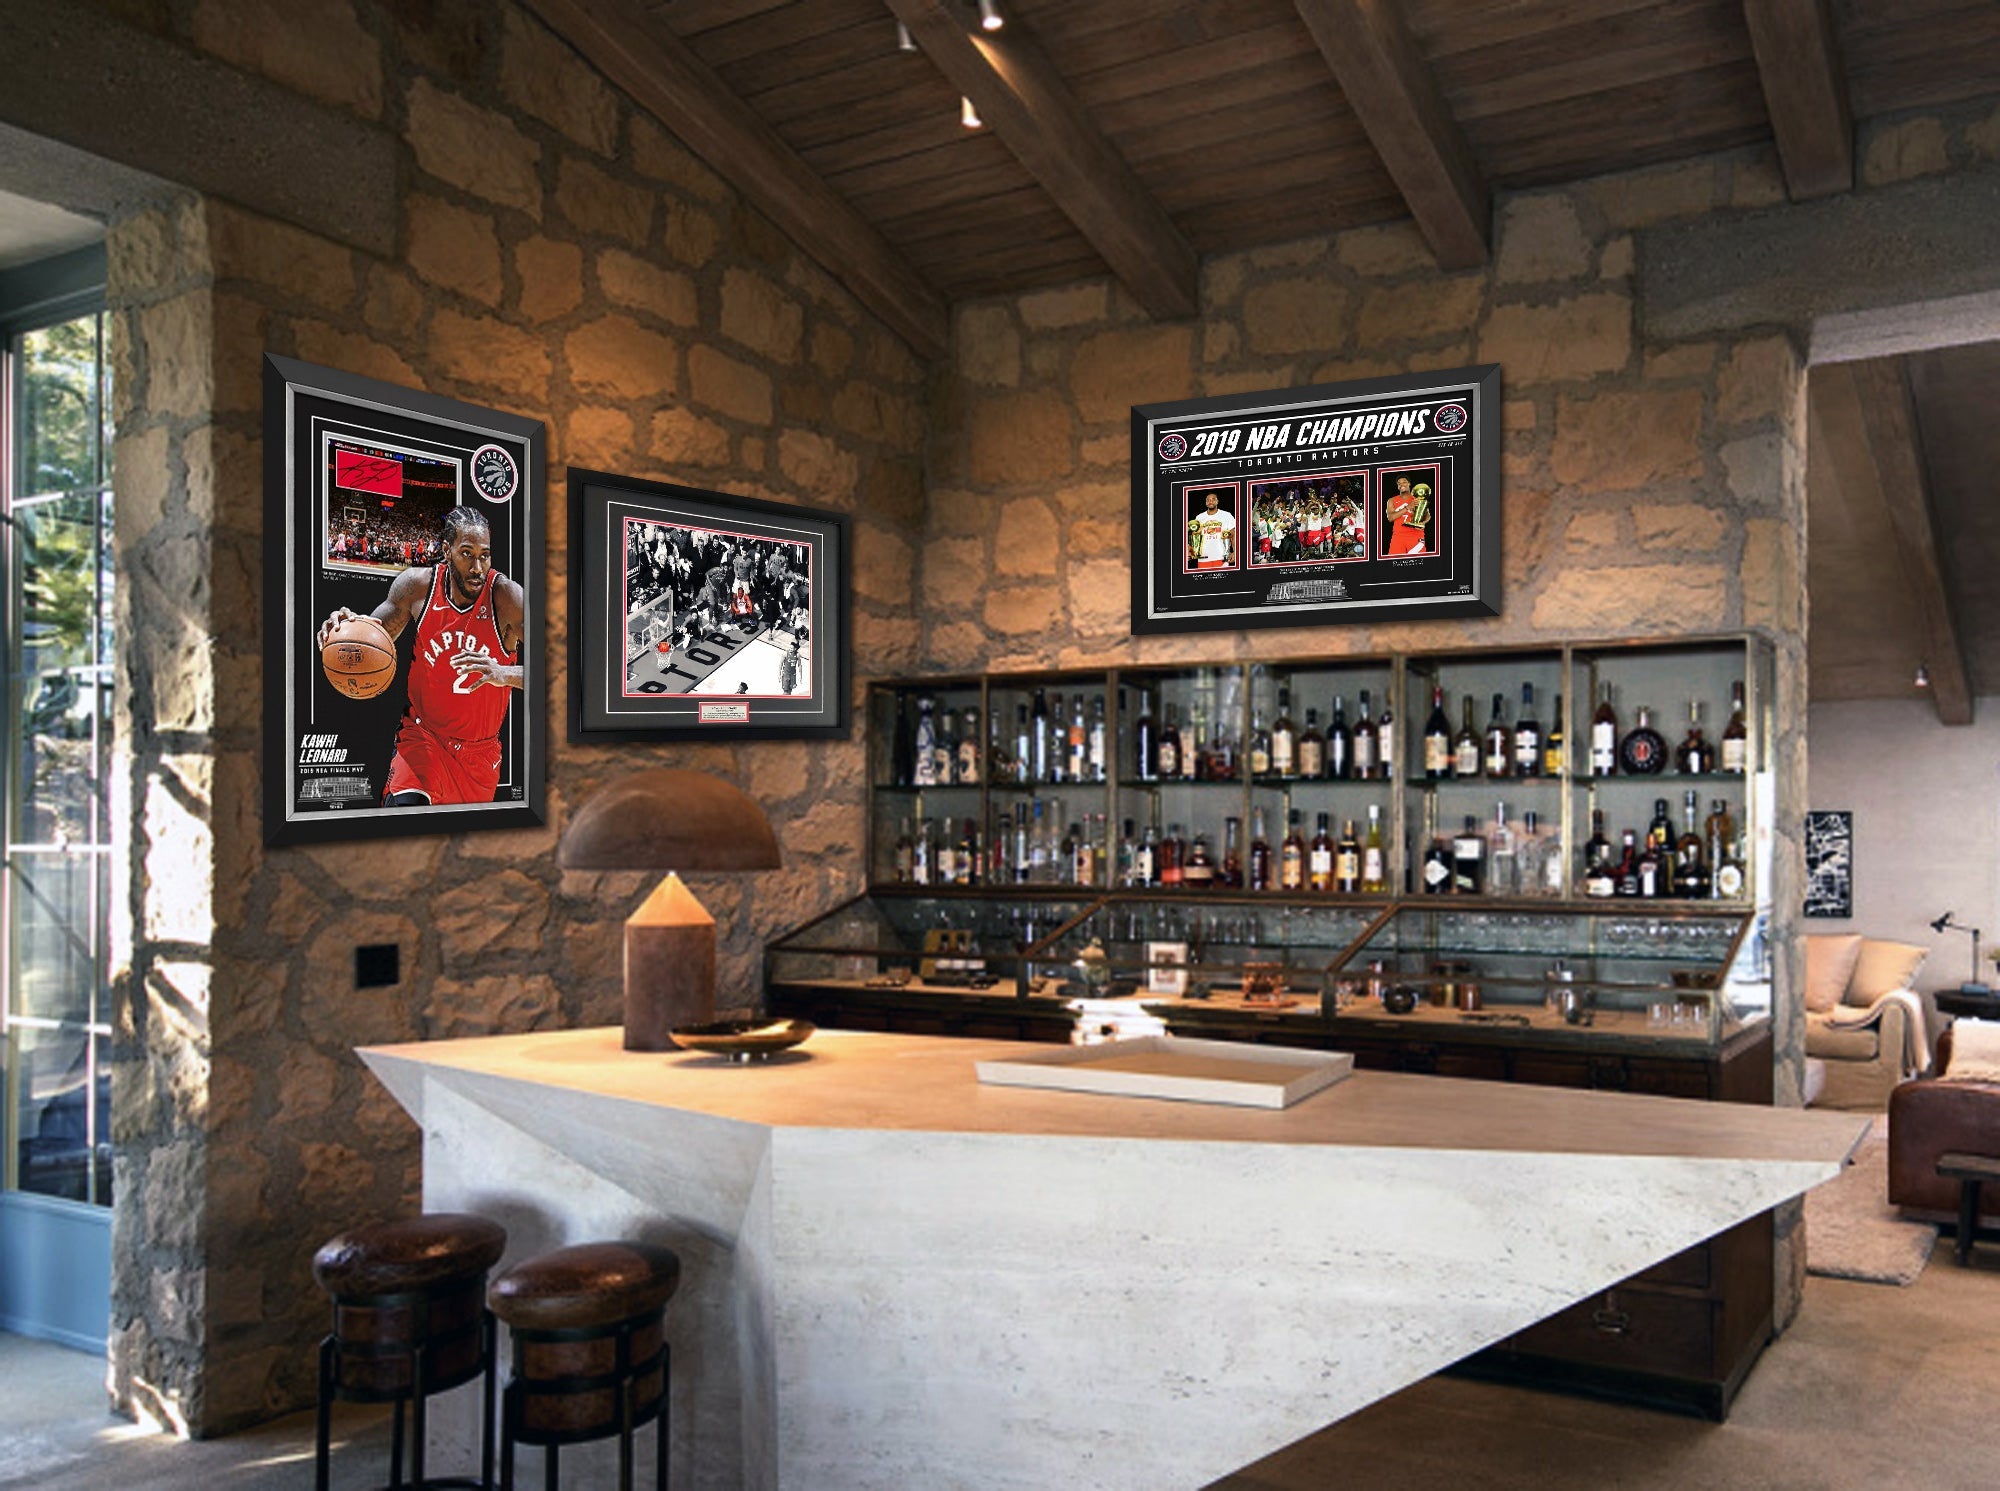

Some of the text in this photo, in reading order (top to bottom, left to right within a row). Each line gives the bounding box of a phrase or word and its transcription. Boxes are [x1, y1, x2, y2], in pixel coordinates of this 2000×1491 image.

[1190, 408, 1431, 457] 2019 NBA CHAMPIONS
[477, 451, 512, 472] TORONTO
[1238, 447, 1379, 468] TORONTO RAPTORS
[477, 476, 512, 496] RAPTORS
[300, 734, 339, 749] KAWHI
[299, 748, 348, 764] LEONARD
